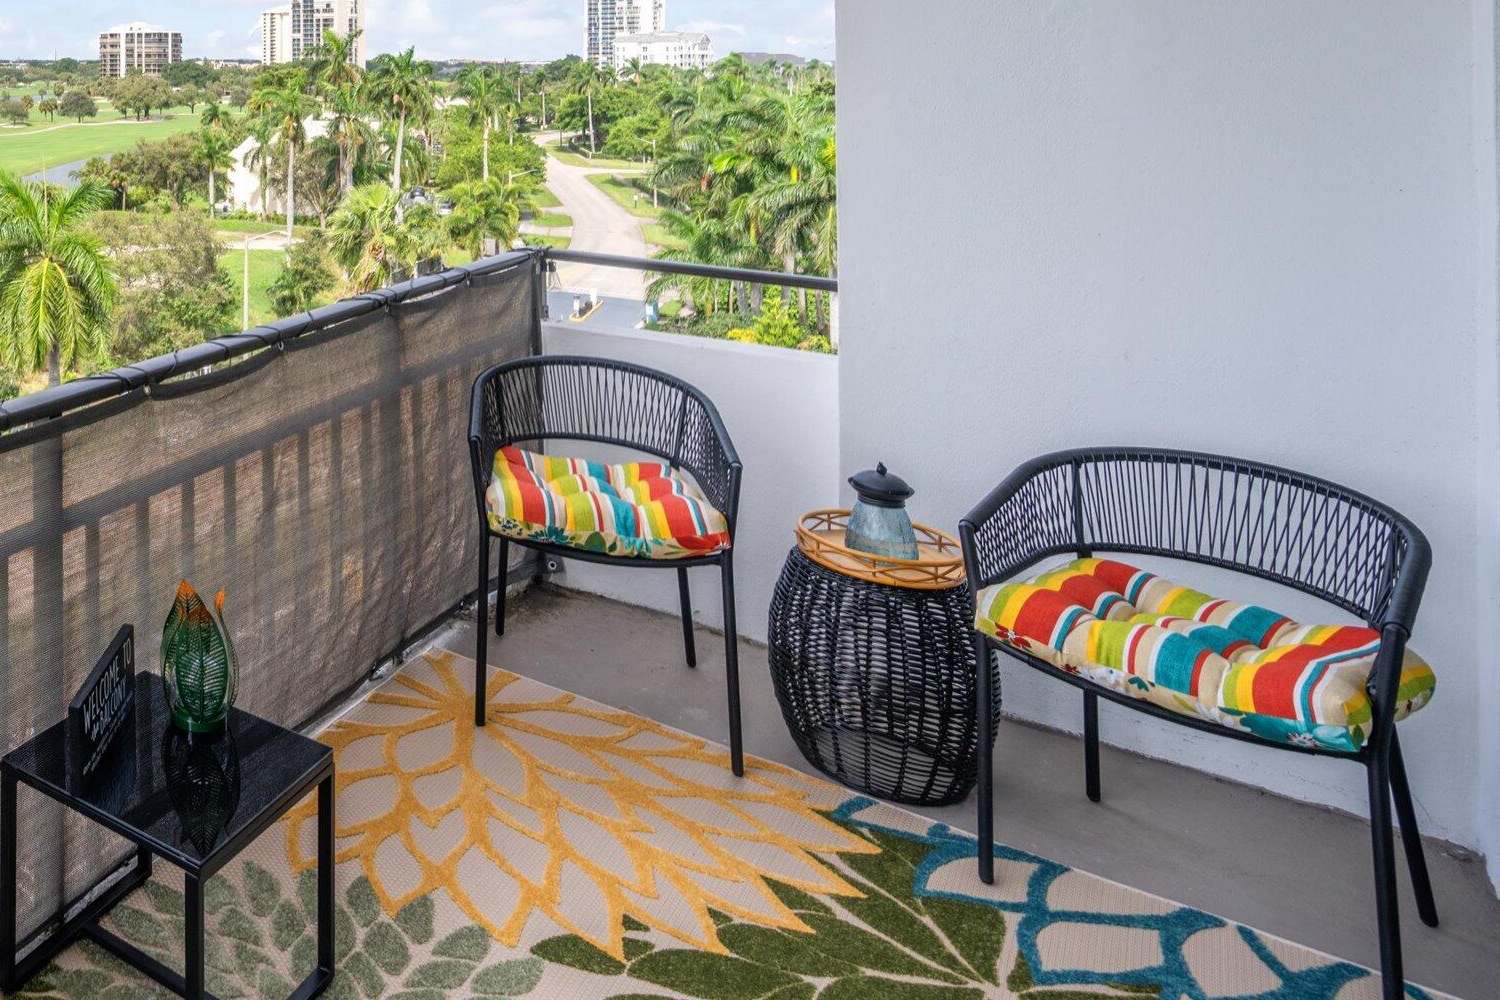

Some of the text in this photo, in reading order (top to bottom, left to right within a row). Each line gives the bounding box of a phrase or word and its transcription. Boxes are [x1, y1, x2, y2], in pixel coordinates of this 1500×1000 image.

[83, 655, 120, 735] WELCOME
[122, 637, 132, 669] TO
[99, 673, 127, 735] BALCONY
